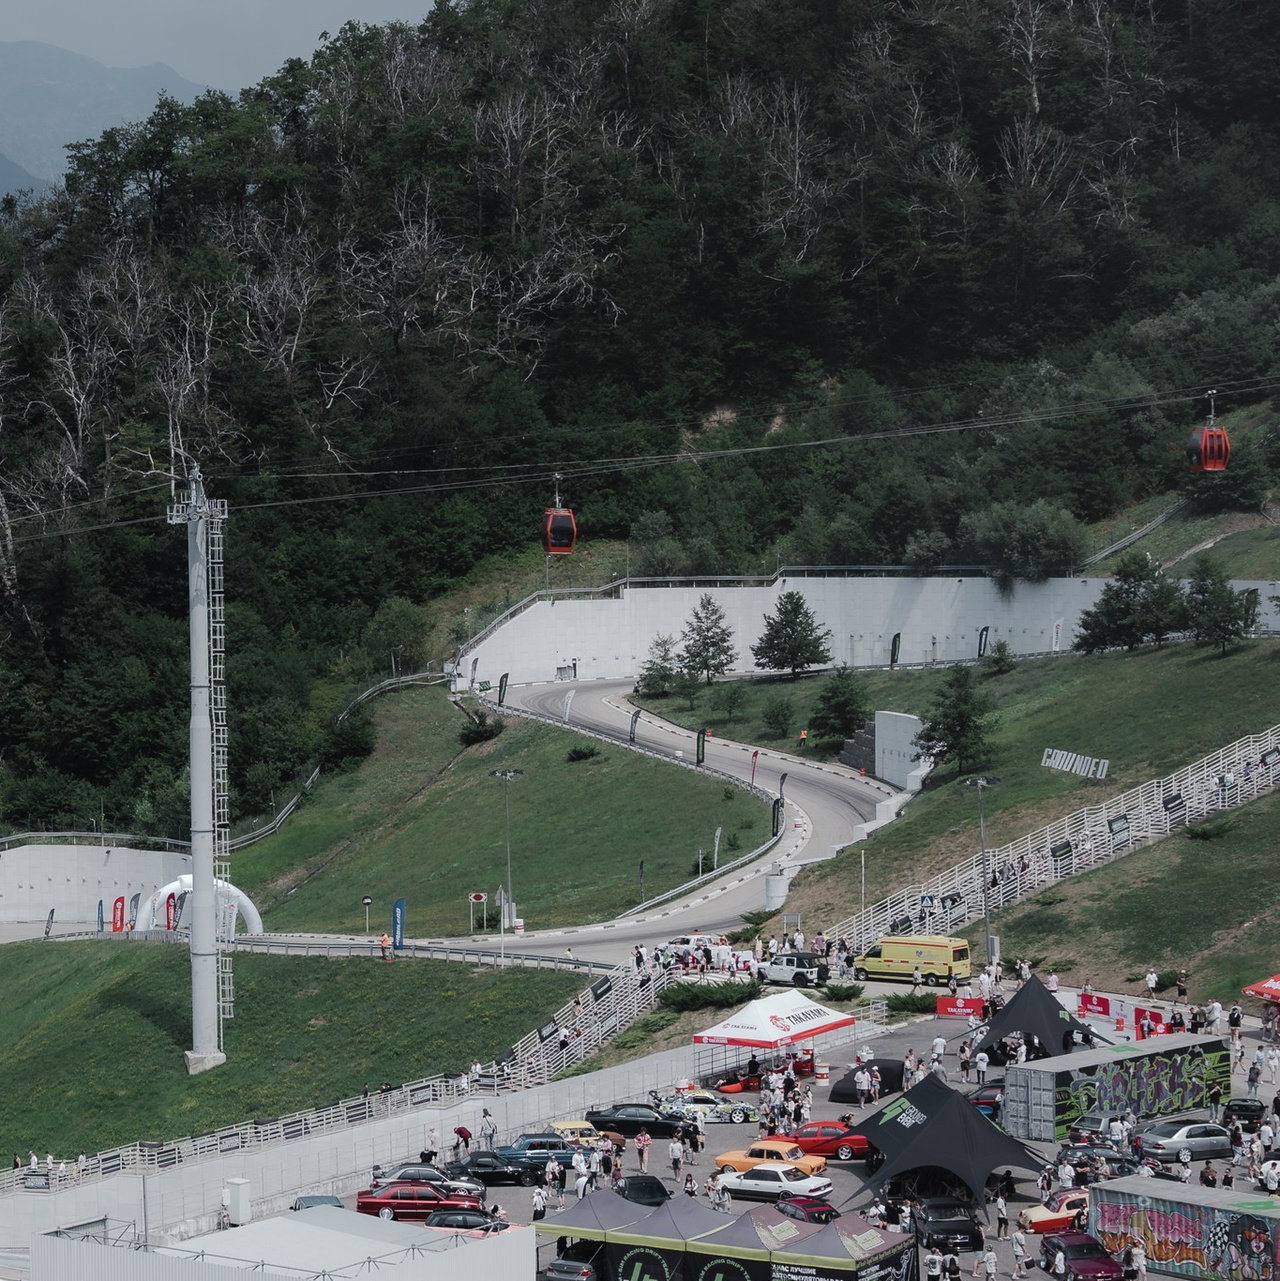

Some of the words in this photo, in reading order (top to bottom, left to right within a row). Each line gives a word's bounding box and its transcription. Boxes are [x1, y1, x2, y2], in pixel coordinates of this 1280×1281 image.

[1041, 748, 1109, 779] GROUNDED
[786, 1008, 830, 1025] TAKAYAMA
[623, 1247, 645, 1261] RACING
[645, 1248, 663, 1260] DRIFT
[661, 1259, 670, 1280] TEAM
[703, 1258, 725, 1271] RACING
[726, 1259, 744, 1271] DRIFT
[790, 1266, 817, 1275] ЛУЧШИЕ
